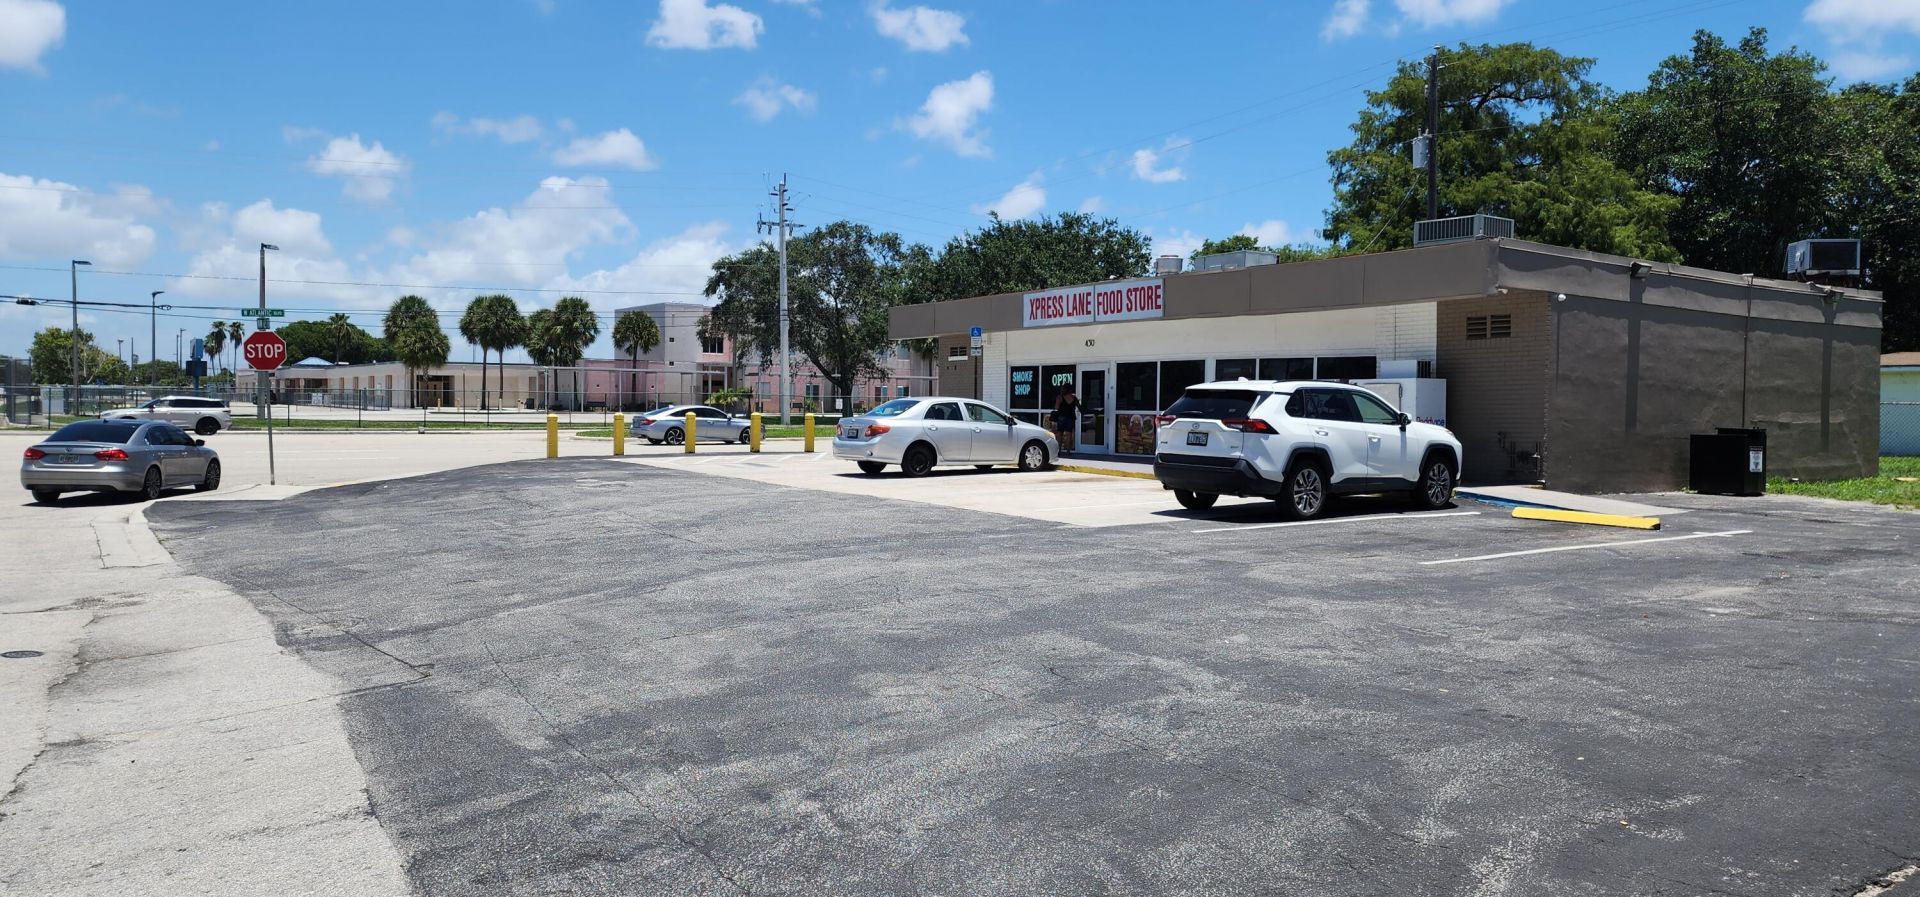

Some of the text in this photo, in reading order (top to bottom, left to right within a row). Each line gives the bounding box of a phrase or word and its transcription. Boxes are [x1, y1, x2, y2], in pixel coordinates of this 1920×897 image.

[1030, 284, 1162, 320] XPRESS LANE FOOD STORE
[246, 344, 283, 358] STOP
[1012, 371, 1033, 382] SMOKE
[1052, 373, 1073, 386] OPEN
[1014, 384, 1031, 396] SHOP
